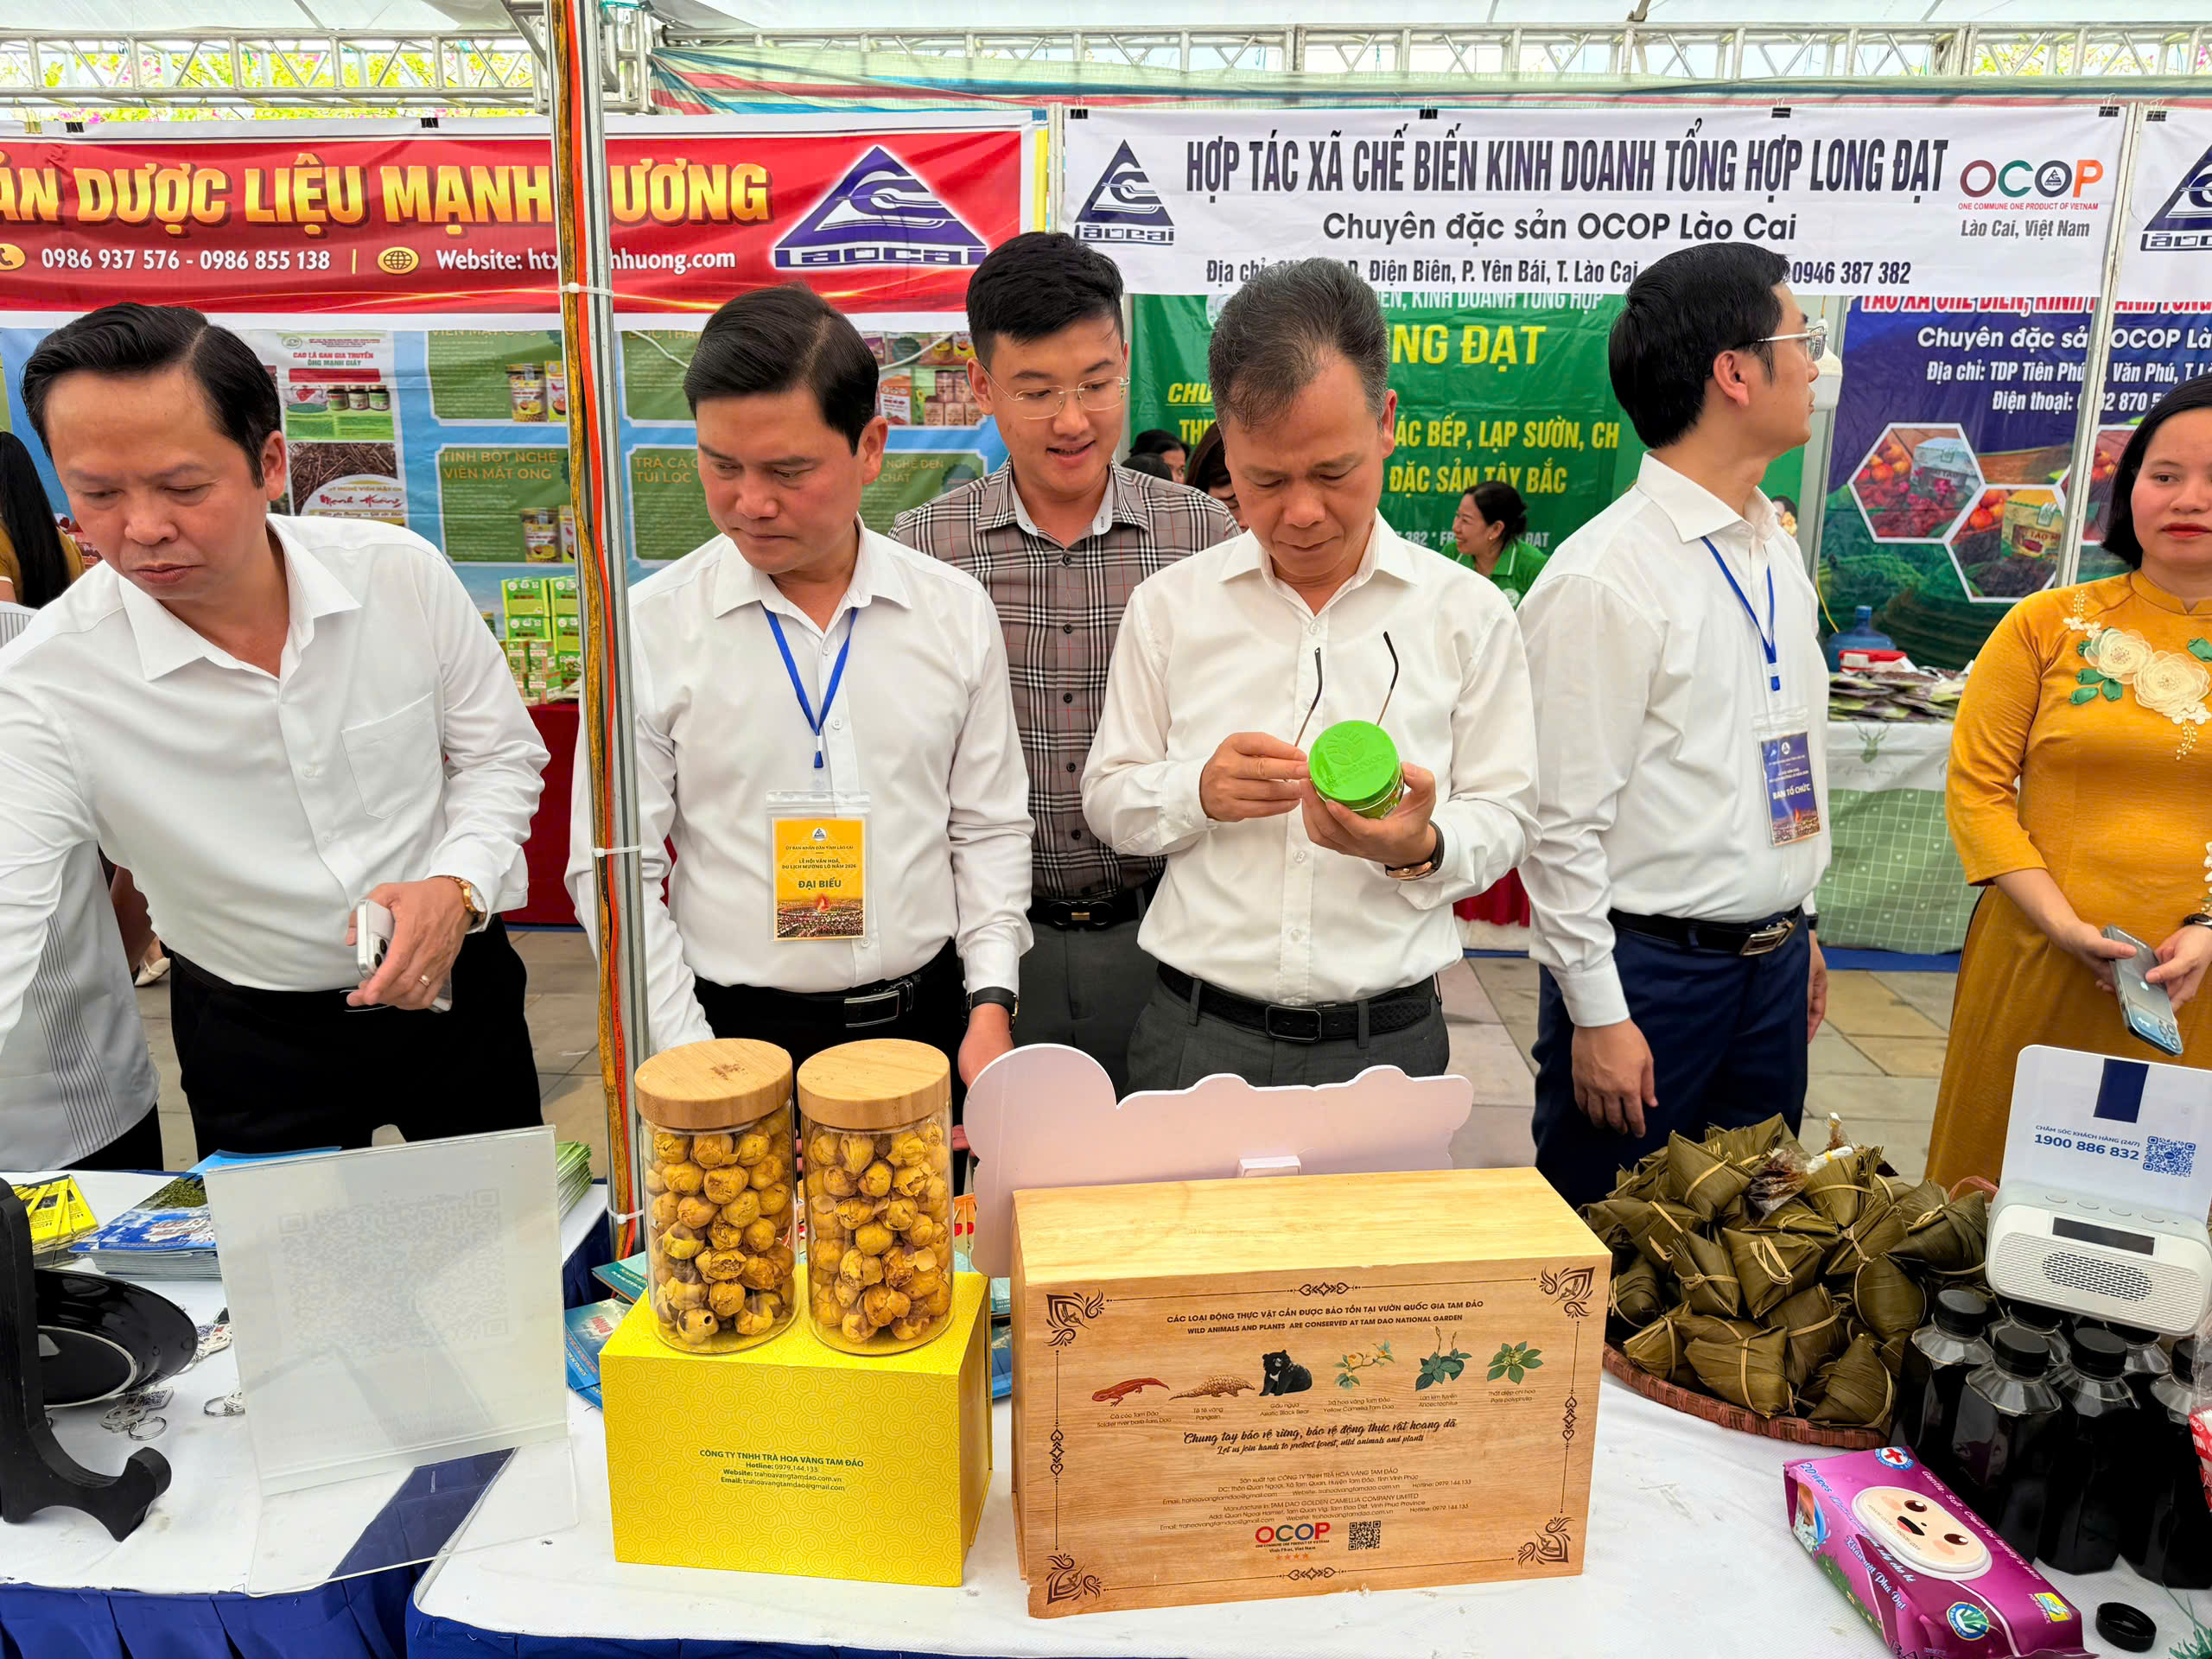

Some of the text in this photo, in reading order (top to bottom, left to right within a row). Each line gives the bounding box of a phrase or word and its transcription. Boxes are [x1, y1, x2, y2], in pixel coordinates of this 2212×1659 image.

[1186, 118, 1949, 203] HỢP TÁC XÃ CHẾ BIẾN KINH DOANH TỔNG HỢP LONG ĐẠT
[1960, 159, 2103, 198] OCOP
[76, 162, 228, 235] DƯỢC
[245, 153, 365, 235] LIỆU
[380, 165, 553, 235] MẠNH
[608, 158, 769, 223] ƯƠNG
[1323, 209, 1796, 247] Chuyên đặc sản OCOP Lào Cai
[1961, 219, 2090, 240] Lào Cai, Việt Nam
[41, 247, 93, 270] 0986
[99, 247, 136, 270] 937
[143, 248, 180, 270] 576
[200, 249, 251, 270] 0986
[255, 249, 290, 270] 855
[297, 250, 331, 270] 138
[435, 249, 522, 270] Website:
[1206, 259, 1234, 287] Địa
[1369, 259, 1408, 286] Điện
[1413, 260, 1458, 284] Biên,
[1462, 261, 1476, 283] P.
[1481, 260, 1514, 283] Yên
[1518, 260, 1550, 285] Bái,
[1557, 261, 1568, 283] T.
[1573, 260, 1605, 283] Lào
[1610, 261, 1638, 283] Cai
[1793, 262, 1834, 283] 0946
[1840, 262, 1873, 283] 387
[1878, 262, 1911, 283] 382
[1460, 325, 1547, 372] ĐẠT
[1917, 326, 2180, 353] Chuyên đặc sả OCOP
[1927, 362, 1952, 385] Địa
[1955, 359, 1986, 382] chỉ:
[1990, 362, 2018, 382] TDP
[2023, 361, 2054, 382] Tiên
[2112, 361, 2140, 383] Văn
[2145, 360, 2179, 385] Phú,
[1992, 391, 2026, 414] Điện
[2030, 391, 2073, 413] thoại:
[2119, 391, 2147, 412] 870
[1427, 412, 1620, 453] BẾP, LẠP SƯỜN, CH
[1389, 461, 1430, 498] ĐẶC
[1435, 458, 1478, 493] SẢN
[1525, 458, 1568, 494] BẮC
[1772, 790, 1786, 800] BAN
[798, 877, 841, 890] ĐẠI BIỂU
[2034, 1134, 2139, 1160] 1900 886 832
[2073, 1131, 2097, 1140] KHÁCH
[2098, 1135, 2120, 1143] HÀNG
[2120, 1139, 2140, 1147] (24/7)
[1166, 1314, 1186, 1323] CÁC
[1188, 1314, 1207, 1324] LOẠI
[1210, 1313, 1235, 1322] ĐỘNG
[1236, 1311, 1258, 1322] THỰC
[1261, 1310, 1277, 1319] VẬT
[1299, 1307, 1324, 1318] ĐƯỢC
[1363, 1306, 1376, 1314] TẠI
[1378, 1303, 1401, 1312] VƯỜN
[1403, 1301, 1428, 1312] QUỐC
[1305, 1319, 1347, 1328] CONSERVED
[1395, 1315, 1432, 1324] NATIONAL
[700, 1449, 724, 1459] CÔNG
[737, 1452, 760, 1461] TNHH
[762, 1452, 778, 1462] TRÀ
[800, 1455, 823, 1465] VÀNG
[774, 1464, 818, 1472] 0979.144.133
[723, 1468, 753, 1477] Website:
[1255, 1522, 1331, 1544] OCOP
